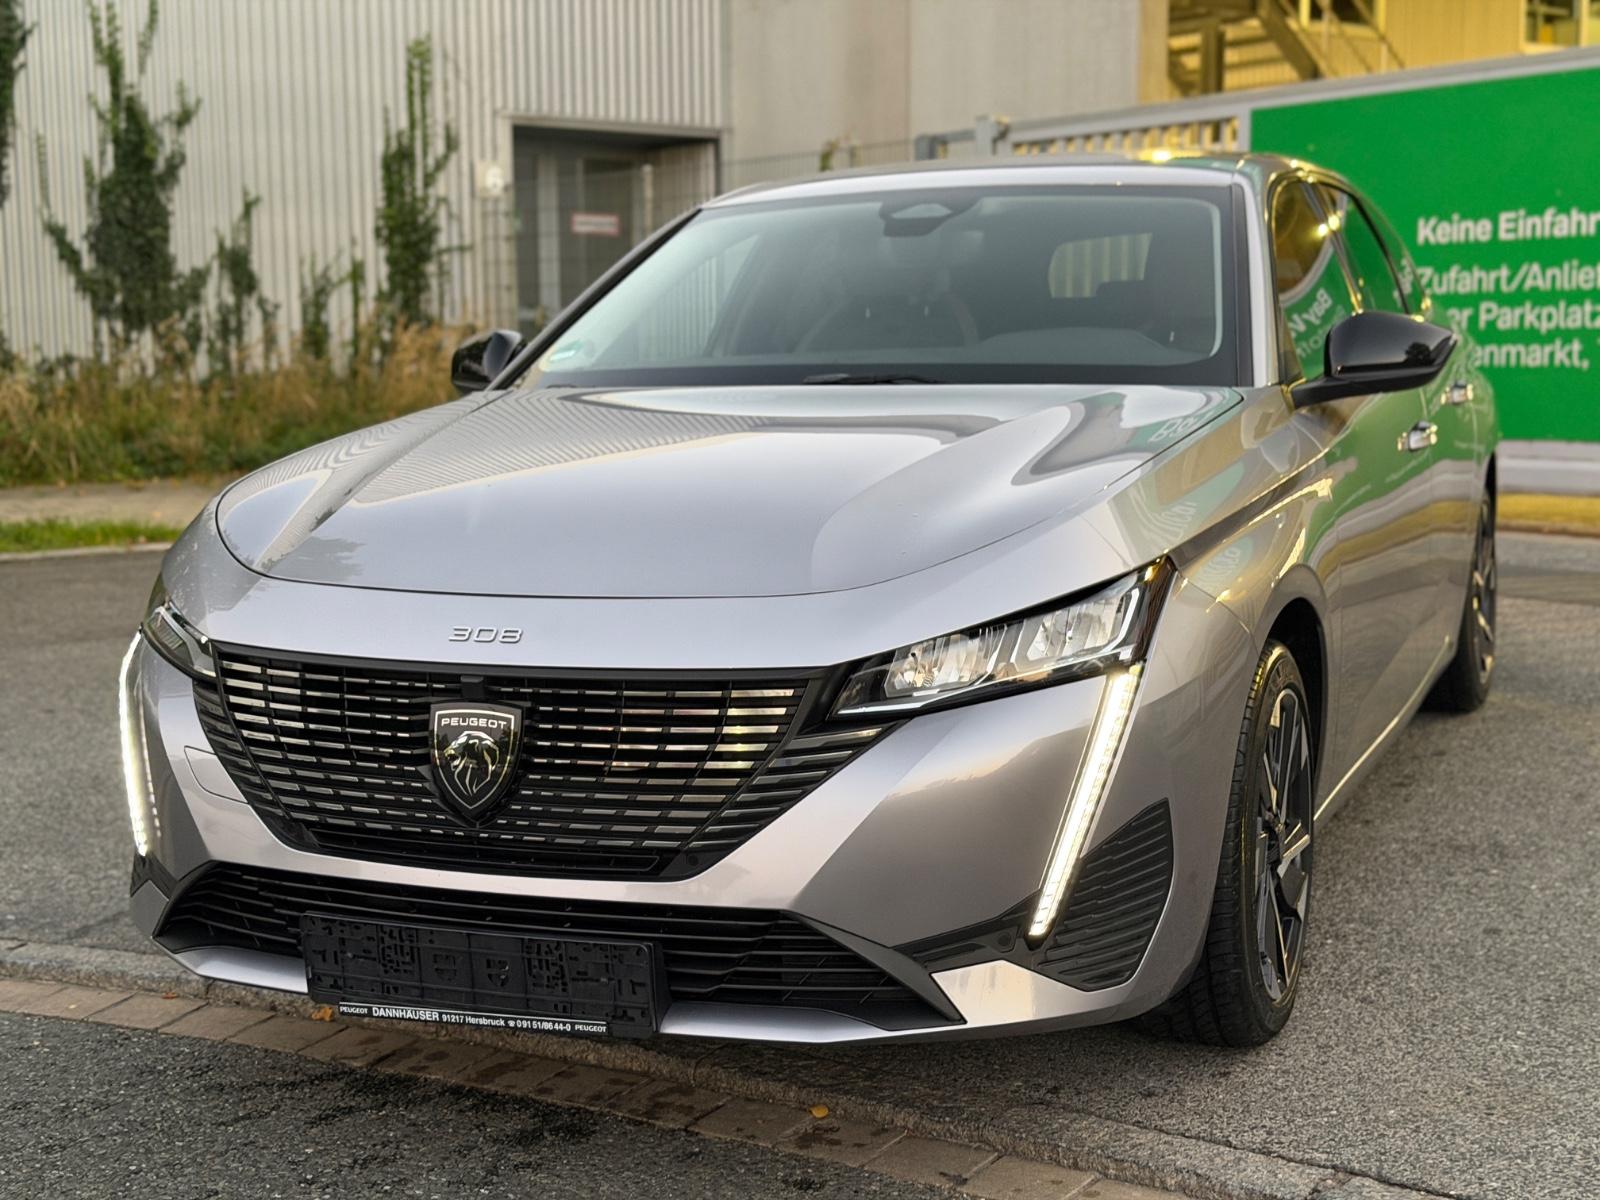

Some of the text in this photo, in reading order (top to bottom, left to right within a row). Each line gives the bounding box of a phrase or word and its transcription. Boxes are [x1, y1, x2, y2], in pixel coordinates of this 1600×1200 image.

[1416, 207, 1600, 246] Keine Einfahr
[1417, 259, 1600, 295] Zufahrt/Anlie
[449, 626, 523, 643] 308
[441, 717, 507, 730] PEUGEOT
[340, 1006, 368, 1015] PEUGEOT
[372, 1006, 440, 1022] DANNHÄUSER
[441, 1014, 464, 1024] 91217
[465, 1015, 506, 1027] Hersbruck
[574, 1024, 607, 1033] PEUGEOT
